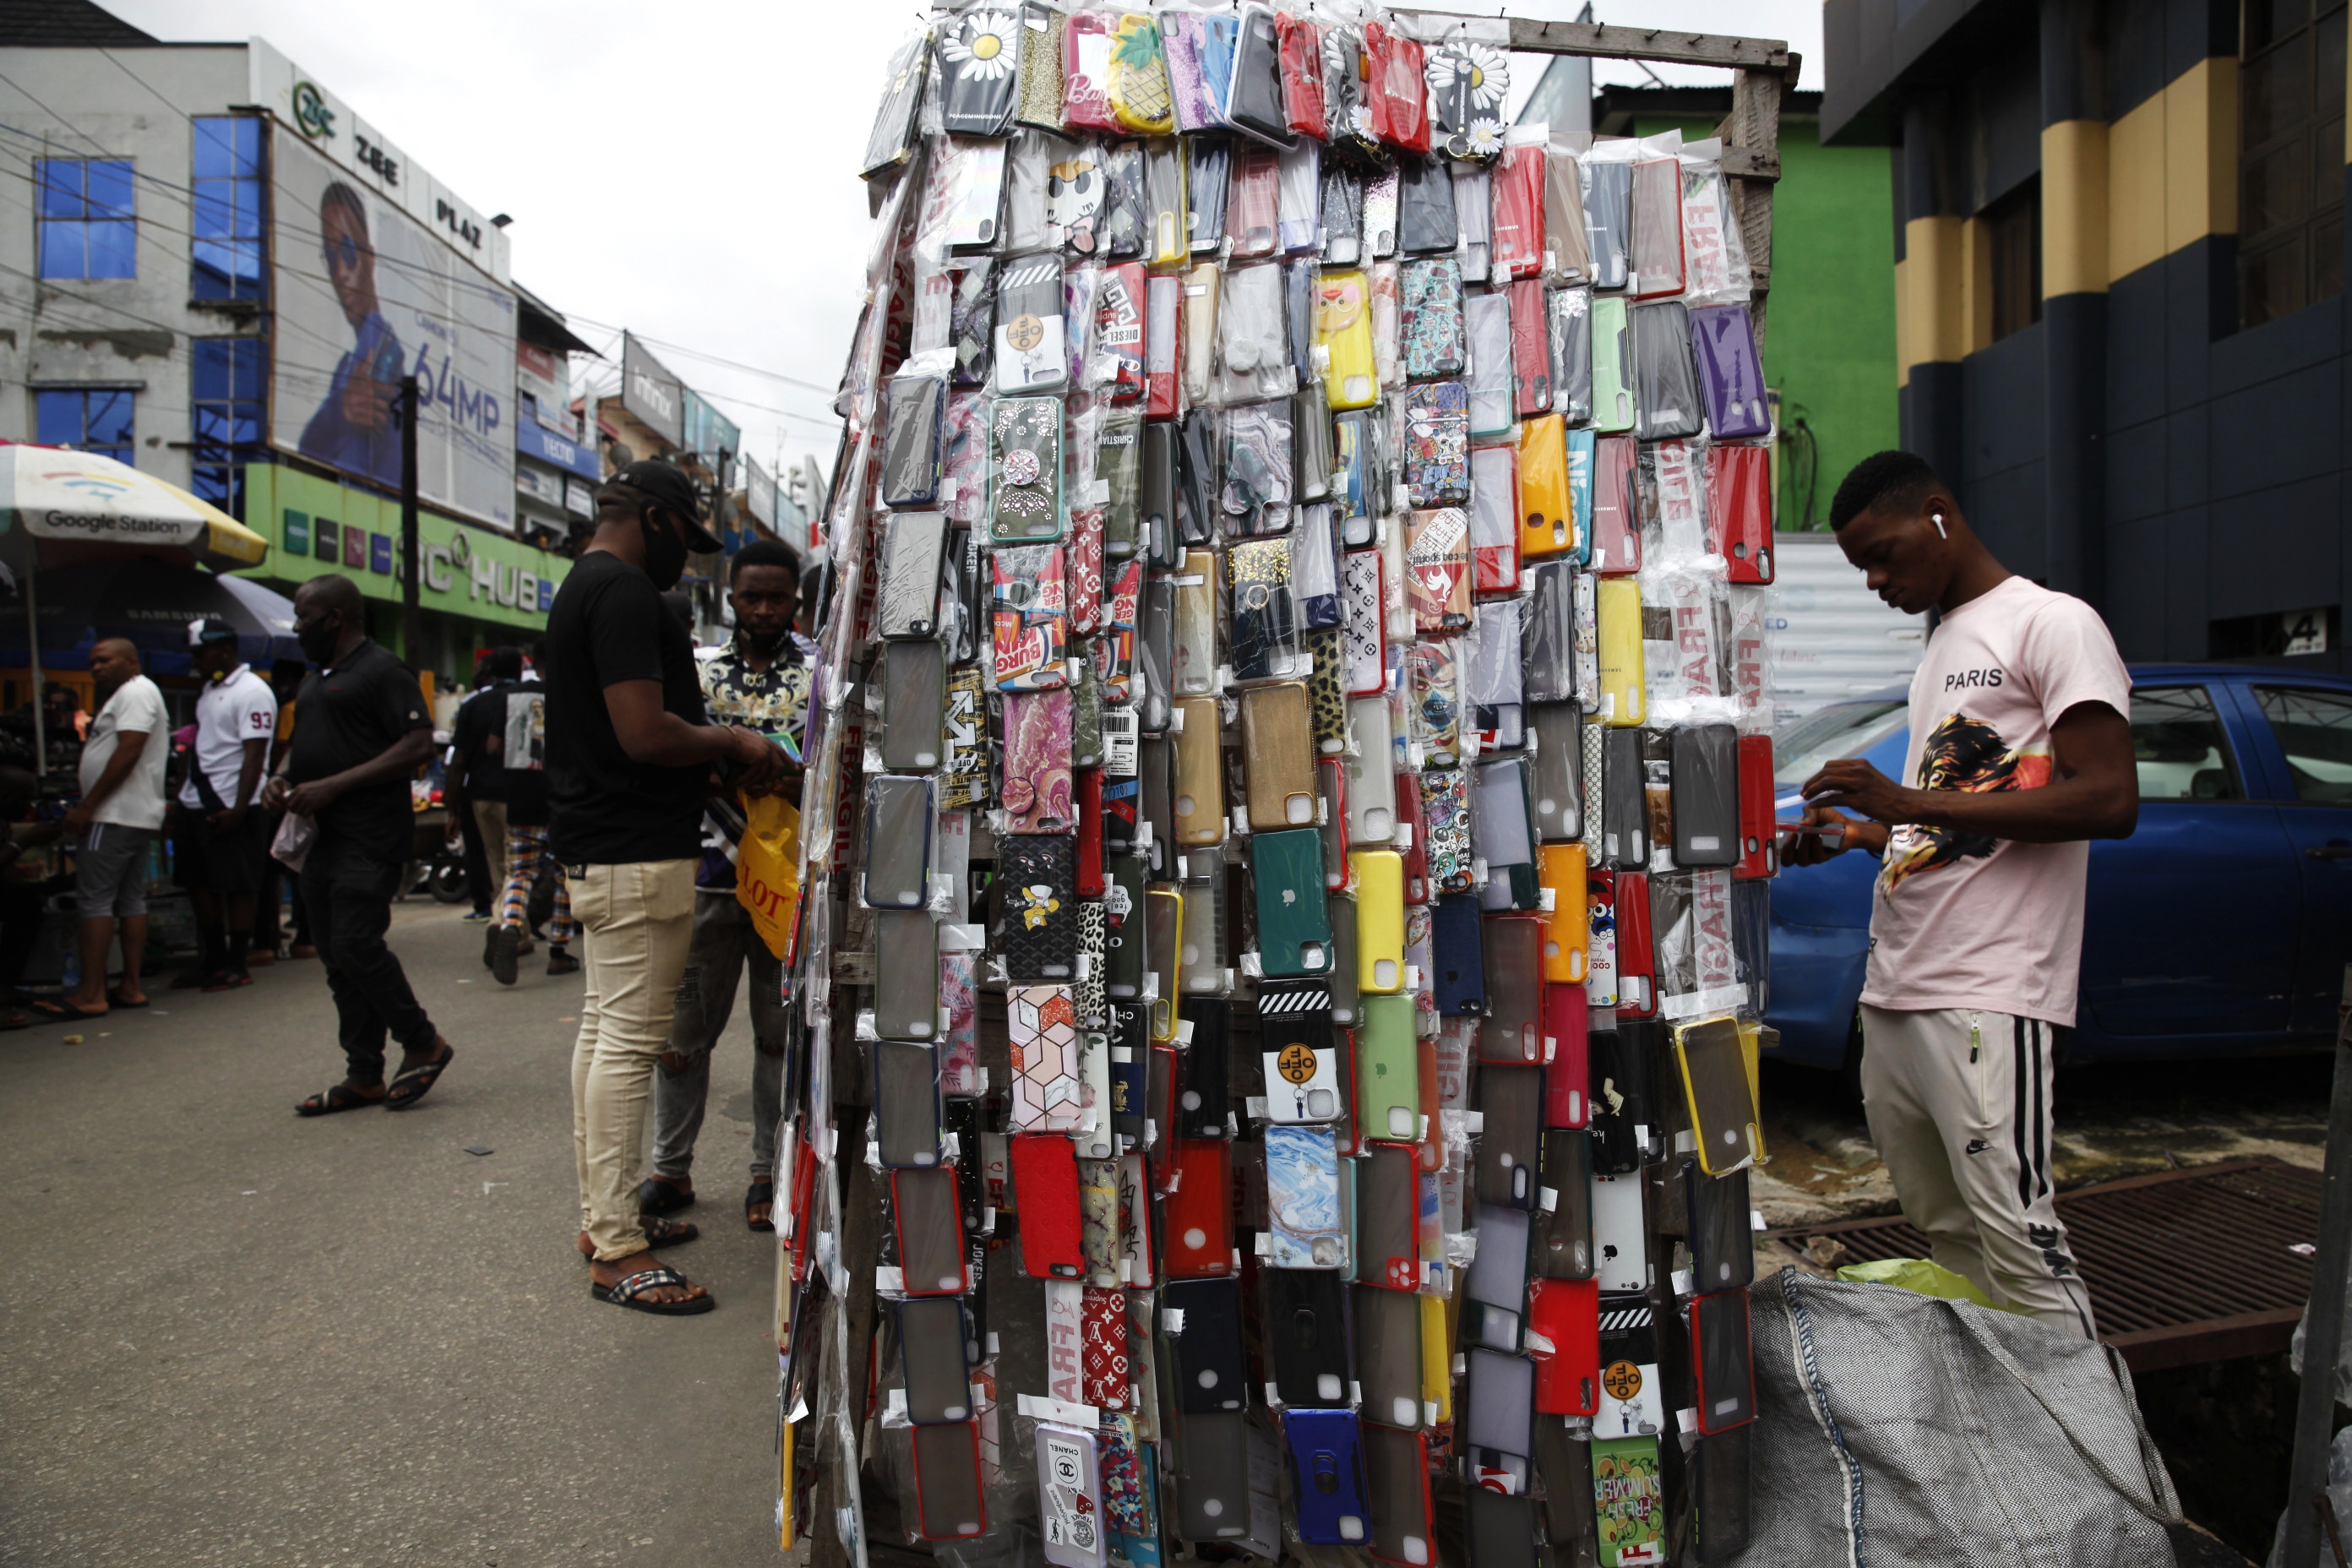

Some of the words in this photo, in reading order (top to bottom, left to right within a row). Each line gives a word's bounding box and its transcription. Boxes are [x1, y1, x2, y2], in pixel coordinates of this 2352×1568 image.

[355, 134, 399, 188] ZEE
[1110, 330, 1138, 342] DIESEL
[414, 342, 500, 437] 64MP
[46, 509, 117, 532] Google
[119, 515, 182, 535] Station
[470, 553, 537, 612] HUB
[2292, 614, 2318, 642] 4
[1945, 668, 2002, 692] PARIS
[251, 711, 271, 729] 93
[958, 759, 972, 768] OFF
[972, 1243, 983, 1281] JOKER
[1048, 1443, 1080, 1456] CHANEL
[1594, 1474, 1660, 1502] SUMMER
[1609, 1499, 1652, 1518] FRESH
